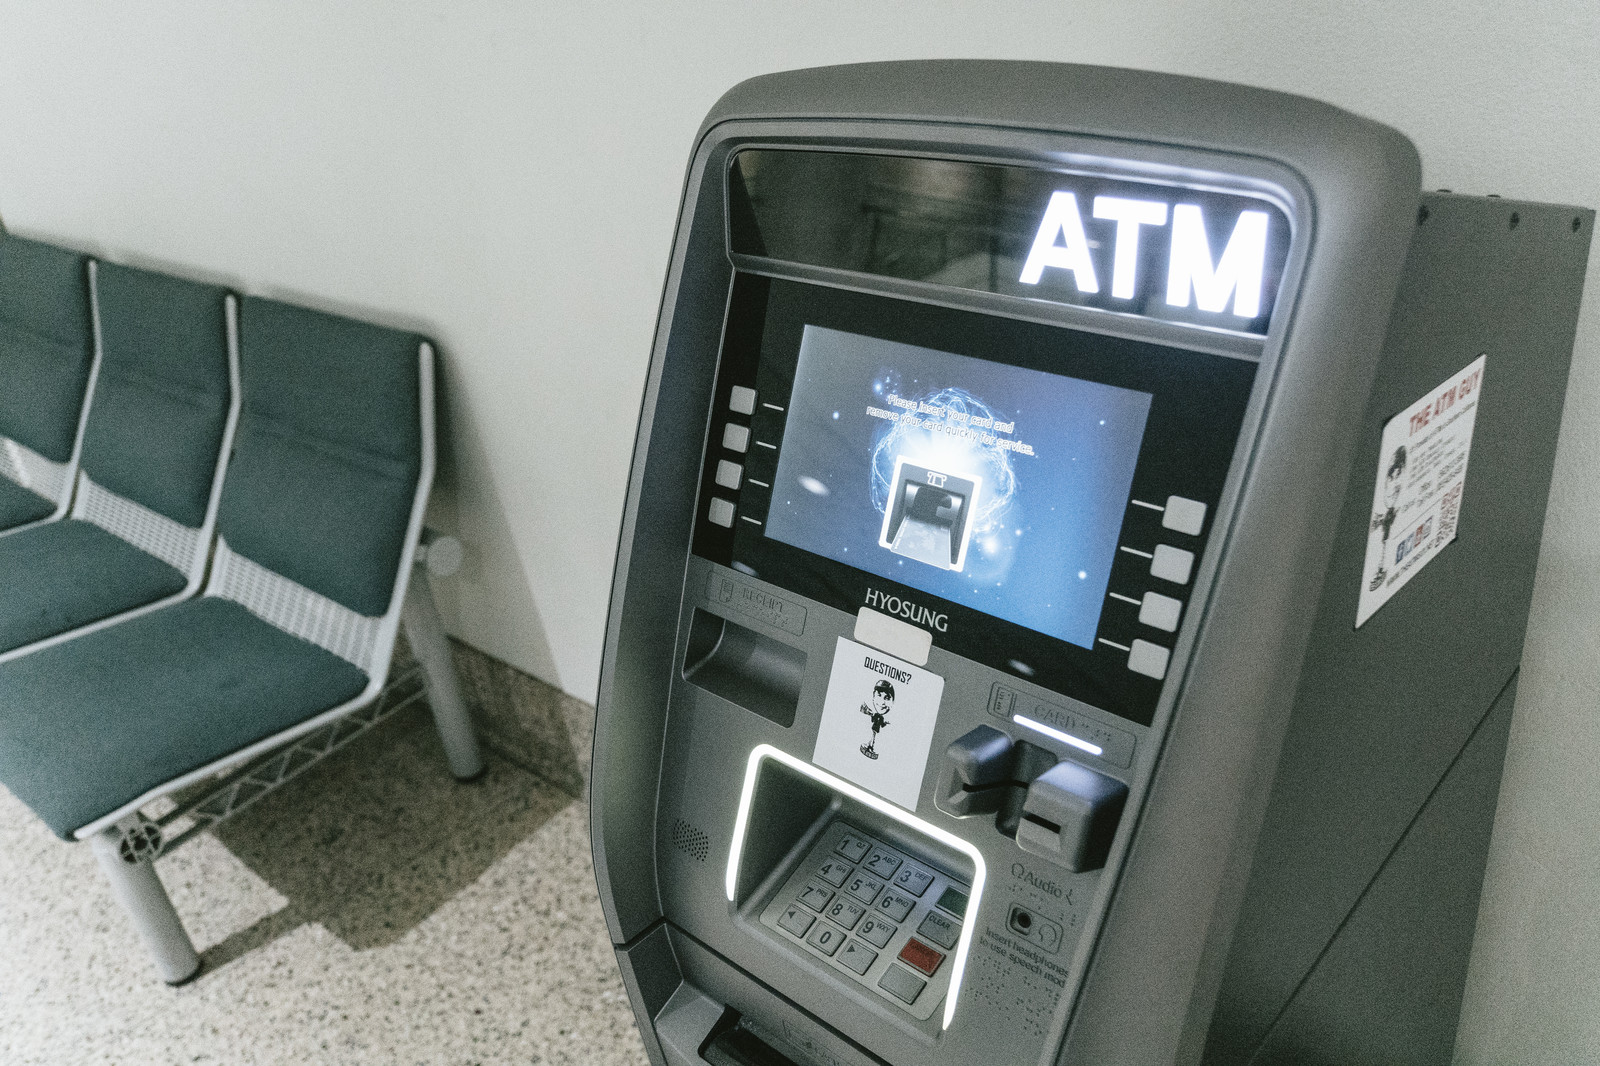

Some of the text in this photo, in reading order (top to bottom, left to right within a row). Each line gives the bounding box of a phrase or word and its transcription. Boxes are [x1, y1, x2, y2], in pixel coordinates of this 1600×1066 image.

[1019, 190, 1269, 318] ATM
[1409, 403, 1432, 437] THE
[1432, 386, 1457, 420] ATM
[1459, 368, 1481, 400] GUY
[887, 394, 1015, 434] Please insert your card and
[866, 406, 1035, 456] remove your card quickly for service.
[865, 587, 949, 633] HYOSUNG
[864, 656, 912, 685] QUESTIONS?
[1034, 704, 1076, 729] CARD
[840, 839, 850, 851] 1
[867, 854, 896, 868] 2 ABC
[820, 864, 846, 875] 4 GHI
[900, 870, 927, 883] 3 DEF
[801, 886, 828, 898] 7 PRS
[850, 879, 877, 891] 5 JKL
[1023, 871, 1062, 898] Audio
[832, 903, 859, 916] 8 TUV
[881, 895, 909, 909] 6 MNO
[862, 921, 891, 934] 9 WXY
[928, 914, 951, 930] CLEAR
[819, 931, 832, 945] 0
[980, 936, 989, 947] to
[990, 942, 1007, 957] use
[1009, 953, 1042, 975] speech
[985, 927, 1068, 978] Insert headphones
